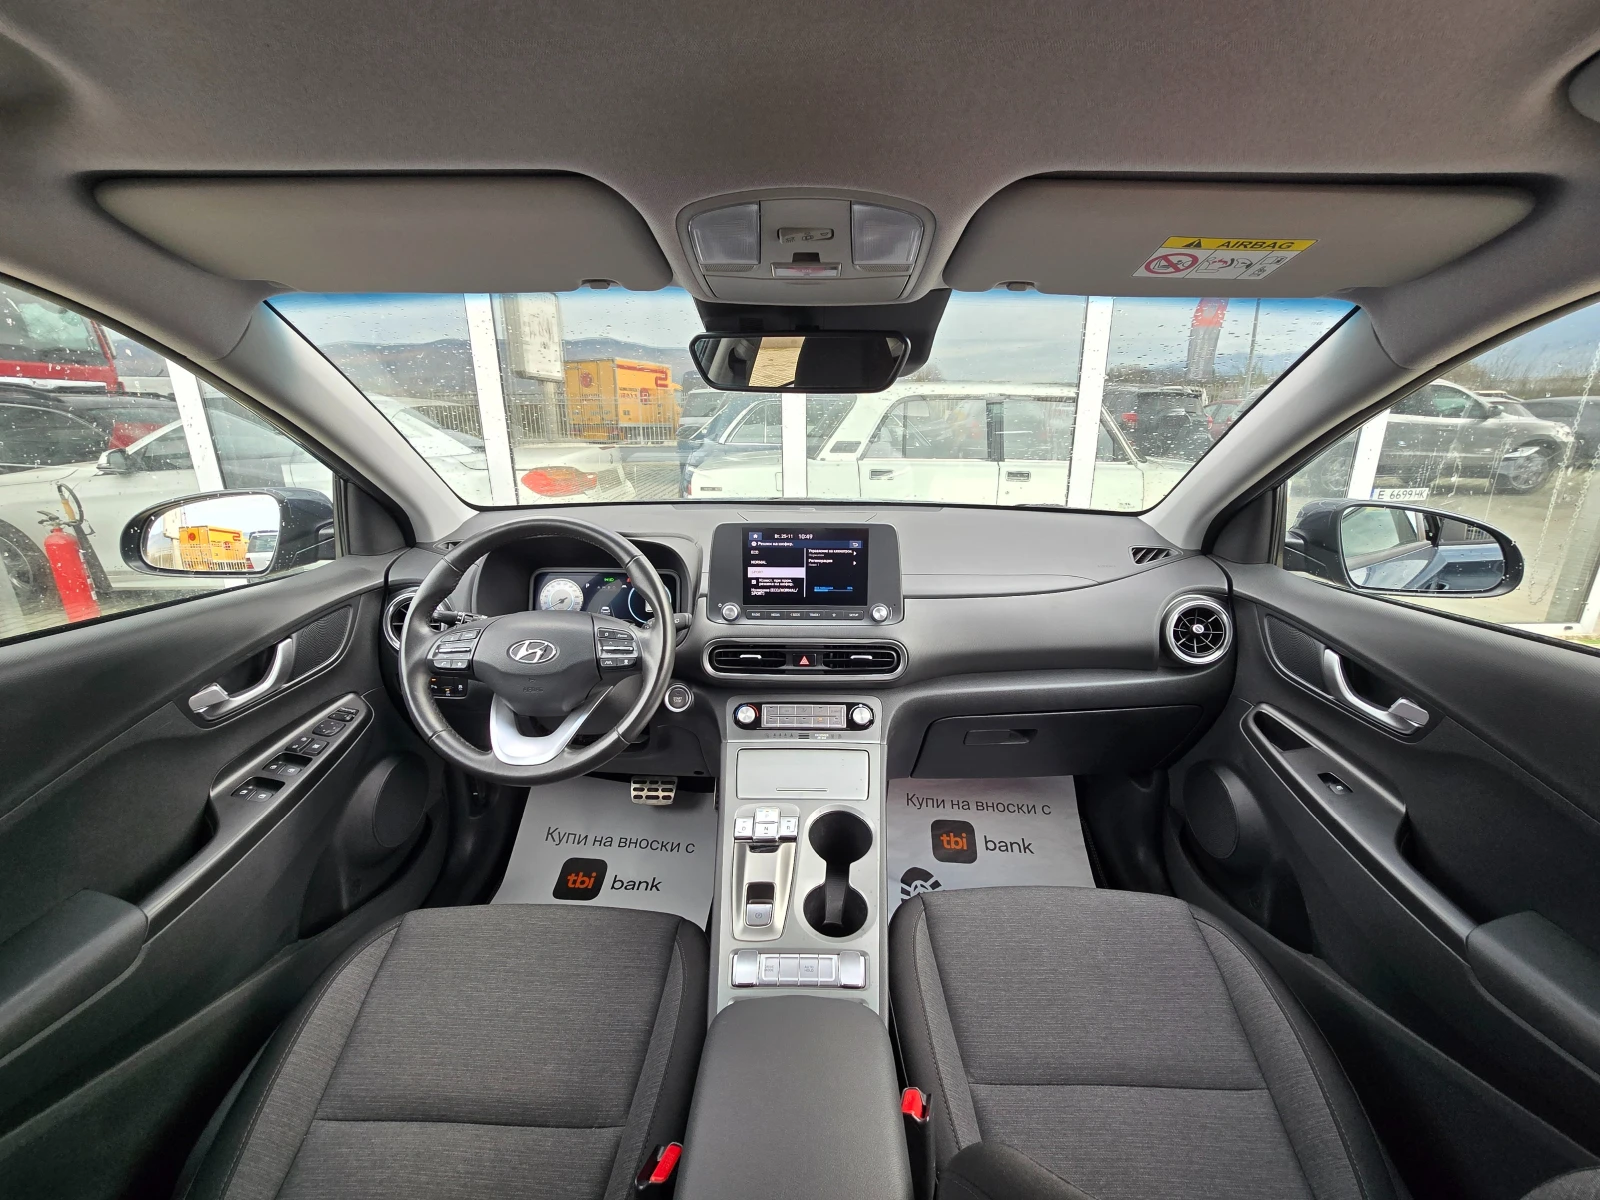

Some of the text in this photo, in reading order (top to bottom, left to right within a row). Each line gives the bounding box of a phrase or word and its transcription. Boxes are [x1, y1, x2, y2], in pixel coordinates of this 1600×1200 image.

[1216, 240, 1295, 250] AIRBAG
[906, 793, 1052, 815] Купи на вноски с
[545, 827, 696, 854] Купи на вноски с
[940, 833, 1035, 854] tbi bank
[567, 871, 662, 892] tbi bank
